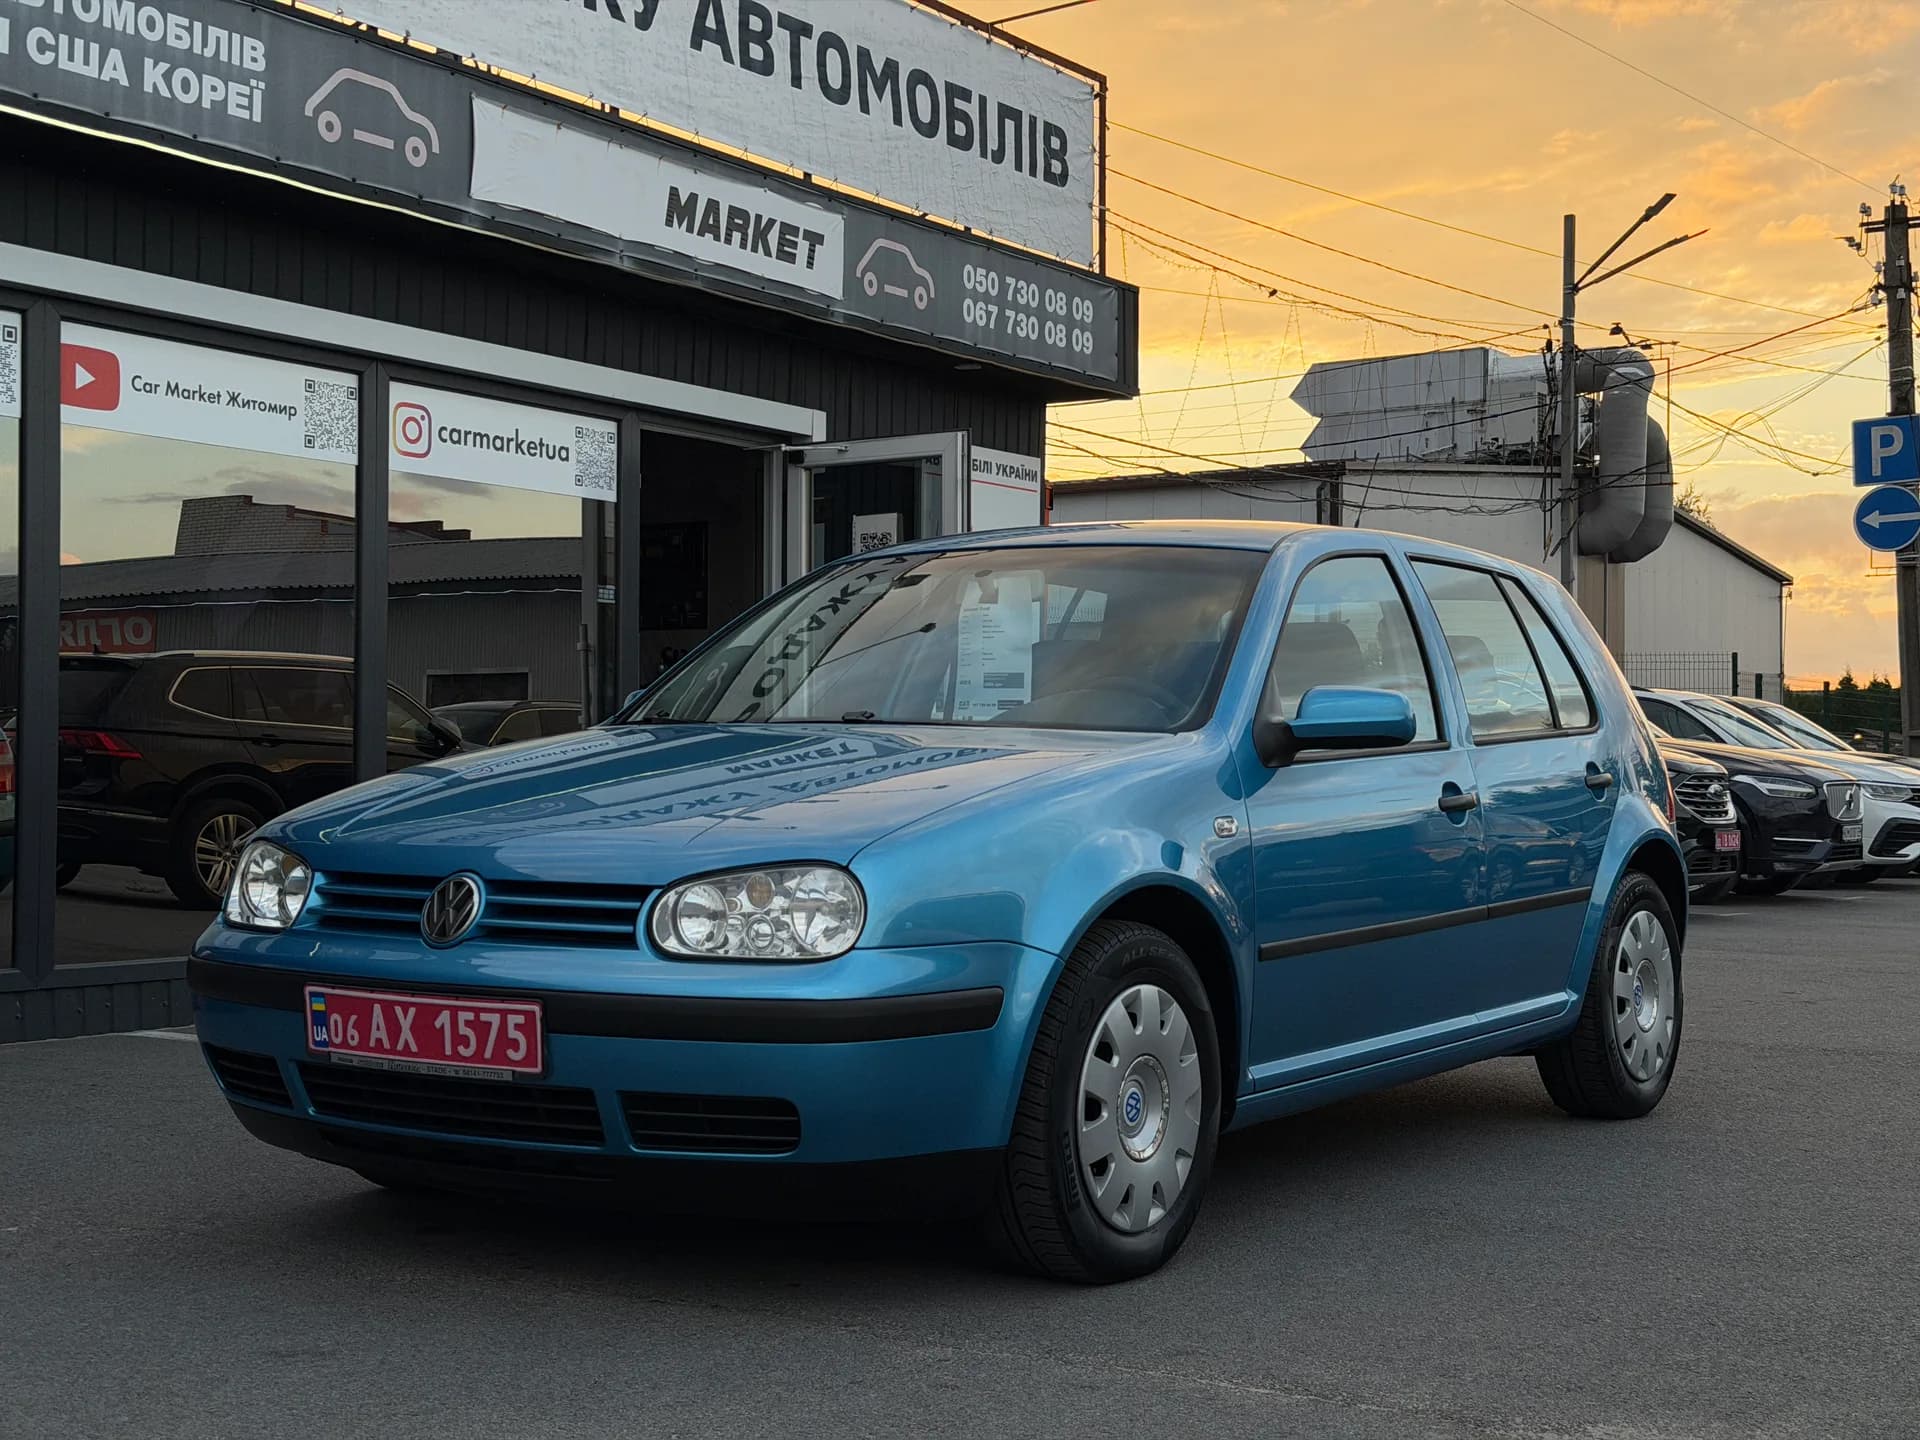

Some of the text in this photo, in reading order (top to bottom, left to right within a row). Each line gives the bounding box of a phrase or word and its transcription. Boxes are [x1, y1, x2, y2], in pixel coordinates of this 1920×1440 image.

[12, 0, 267, 72] ОМОБІЛІВ
[26, 26, 130, 88] США
[143, 56, 266, 123] КОРЕЇ
[689, 0, 1069, 188] АВТОМОБІЛІВ
[664, 185, 825, 271] MARKET
[963, 263, 1094, 324] 050 730 08 09
[962, 297, 1093, 355] 067 730 08 09
[131, 374, 298, 421] Car Market Житомир
[437, 425, 570, 463] carmarketua
[995, 462, 1039, 483] УКРАЇНИ
[1870, 424, 1904, 477] P
[313, 1003, 528, 1062] UA 06 AX 1575
